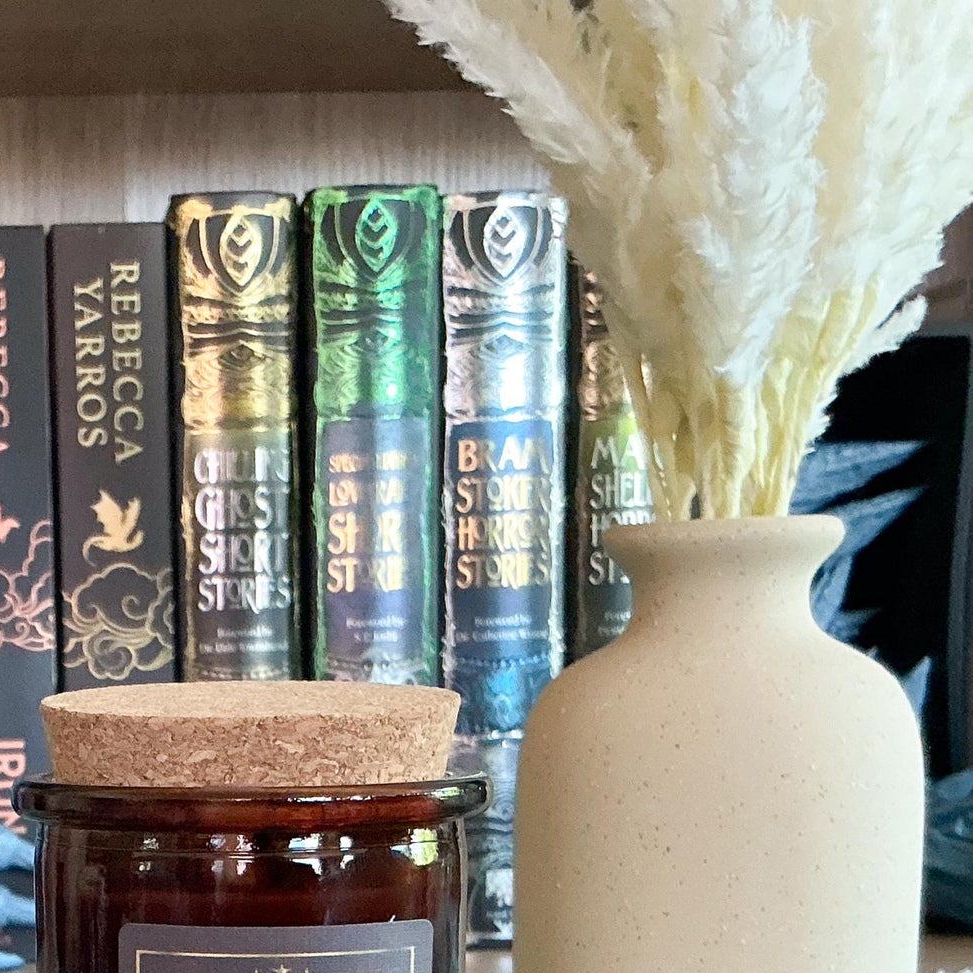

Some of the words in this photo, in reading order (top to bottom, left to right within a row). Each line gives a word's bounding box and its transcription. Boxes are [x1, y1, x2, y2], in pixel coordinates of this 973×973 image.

[75, 278, 108, 447] YARROS
[111, 261, 144, 464] REBECCA
[458, 436, 550, 474] BRAM
[458, 514, 549, 553] HORROR
[456, 552, 550, 590] STORIES
[197, 574, 291, 614] STORIES
